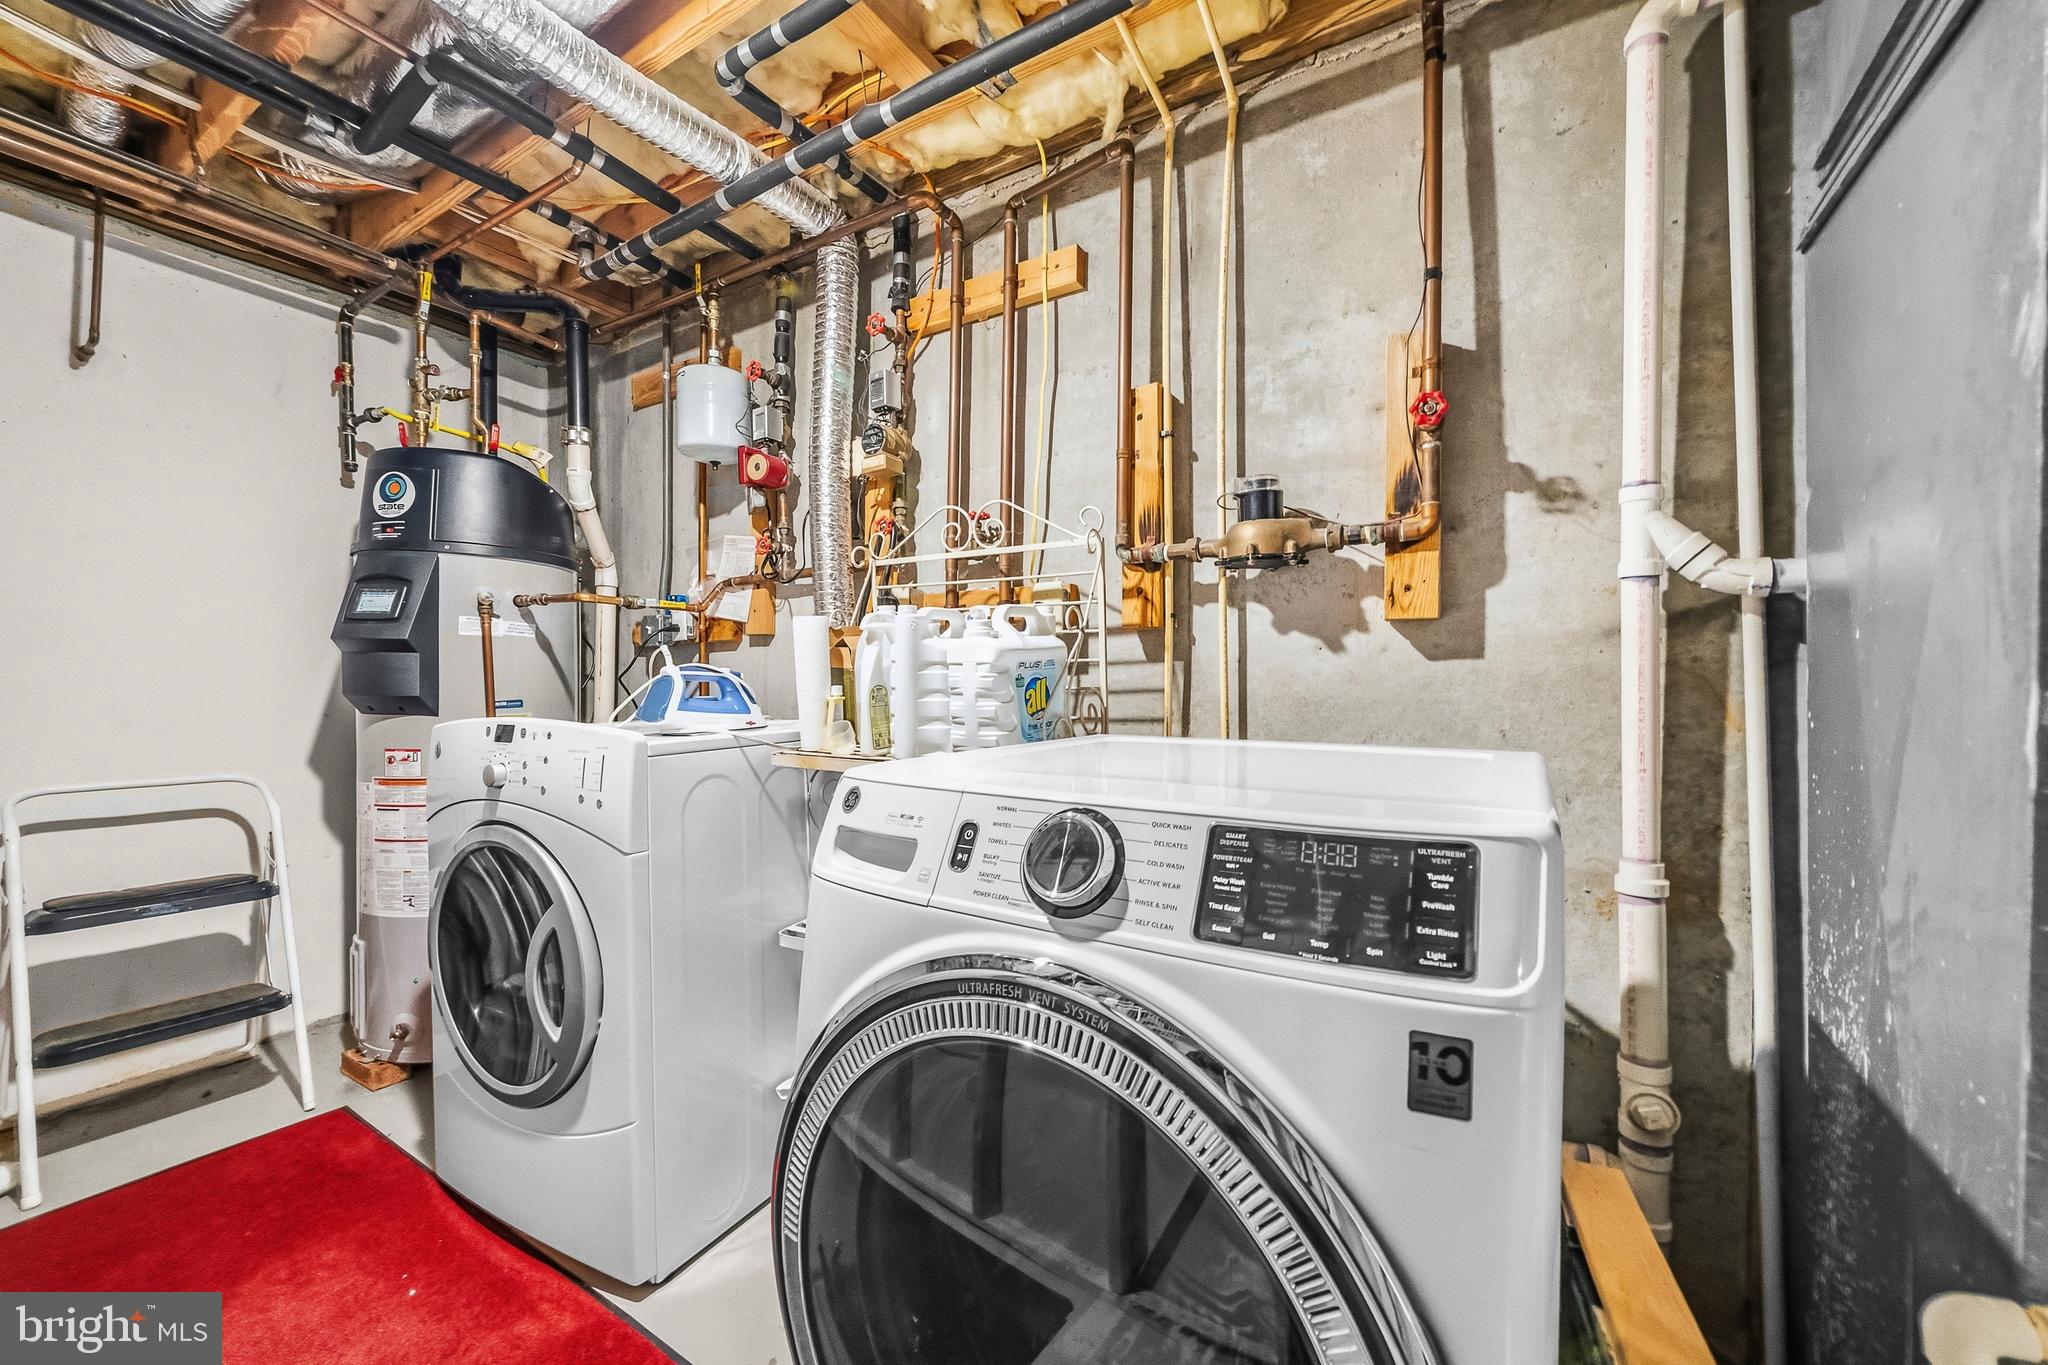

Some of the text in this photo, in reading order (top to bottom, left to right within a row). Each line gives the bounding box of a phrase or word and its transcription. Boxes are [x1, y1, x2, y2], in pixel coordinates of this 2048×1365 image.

[377, 503, 405, 511] state
[1018, 661, 1040, 669] PLUS
[1026, 677, 1047, 715] all
[996, 805, 1018, 813] NORMAL
[992, 821, 1012, 829] WHITES
[1172, 823, 1192, 831] WASH
[1226, 832, 1247, 840] SMART
[988, 837, 1008, 845] TOWELS
[1153, 840, 1188, 849] DELICATES
[1219, 839, 1250, 848] DISPENSE
[1417, 848, 1466, 858] ULTRAFRESH
[1146, 859, 1185, 871] COLD WASH
[1431, 857, 1452, 865] VENT
[978, 871, 1001, 880] SANITIZE
[1426, 872, 1454, 882] Tumble
[1138, 878, 1181, 890] ACTIVE WEAR
[1431, 881, 1449, 890] Care
[972, 889, 1010, 901] POWER CLEAN
[1134, 898, 1154, 908] RINSE
[1161, 902, 1178, 911] SPIN
[1208, 901, 1224, 910] Time
[1134, 918, 1174, 931] SELF CLEAN
[1211, 923, 1232, 933] Sound
[1416, 926, 1459, 938] Extra Rinse
[1309, 938, 1330, 949] Temp
[1366, 947, 1384, 956] Spin
[1426, 950, 1447, 960] Light
[958, 982, 1109, 1033] ULTRAFRESH VENT SYSTEM
